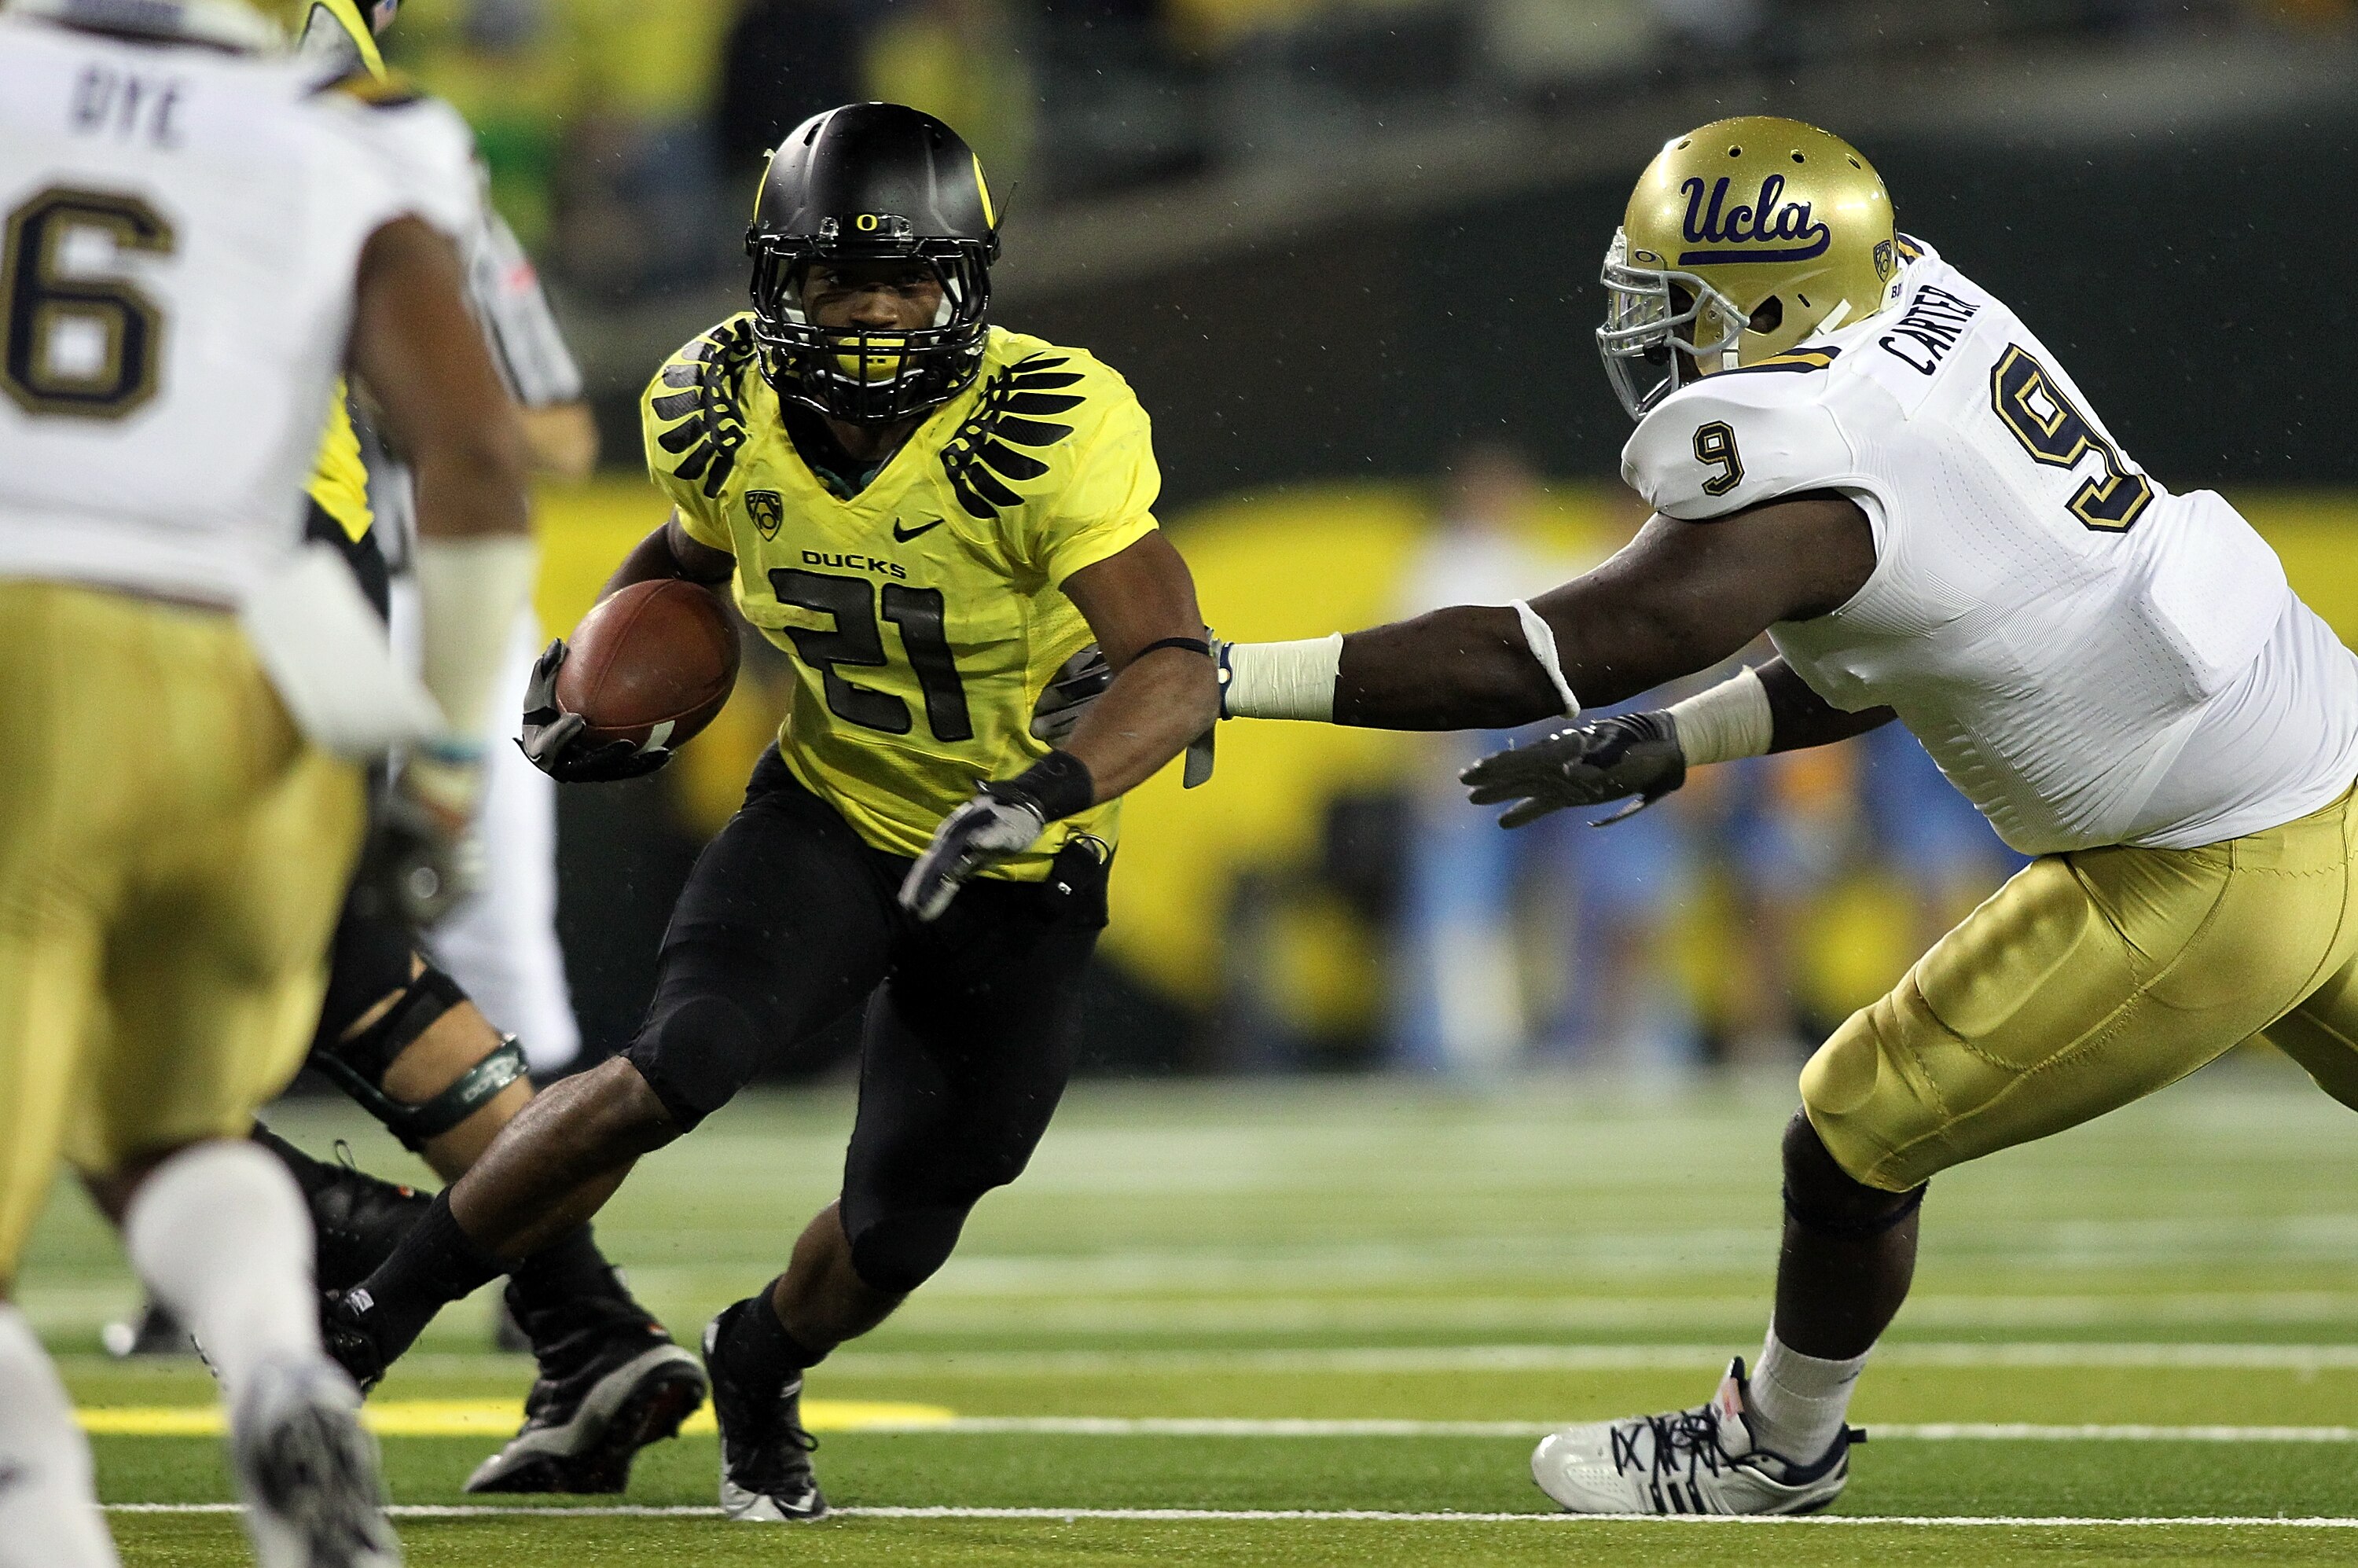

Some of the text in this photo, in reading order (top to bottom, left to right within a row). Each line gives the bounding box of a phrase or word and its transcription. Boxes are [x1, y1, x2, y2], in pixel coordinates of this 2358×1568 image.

[856, 214, 878, 231] O
[1678, 174, 1831, 265] Ucla
[0, 184, 178, 420] 6
[1879, 285, 1981, 376] CARTER
[1692, 420, 1746, 497] 9
[1989, 341, 2154, 533] 9
[757, 512, 777, 530] 10
[802, 550, 906, 579] DUCKS
[768, 567, 973, 742] 21
